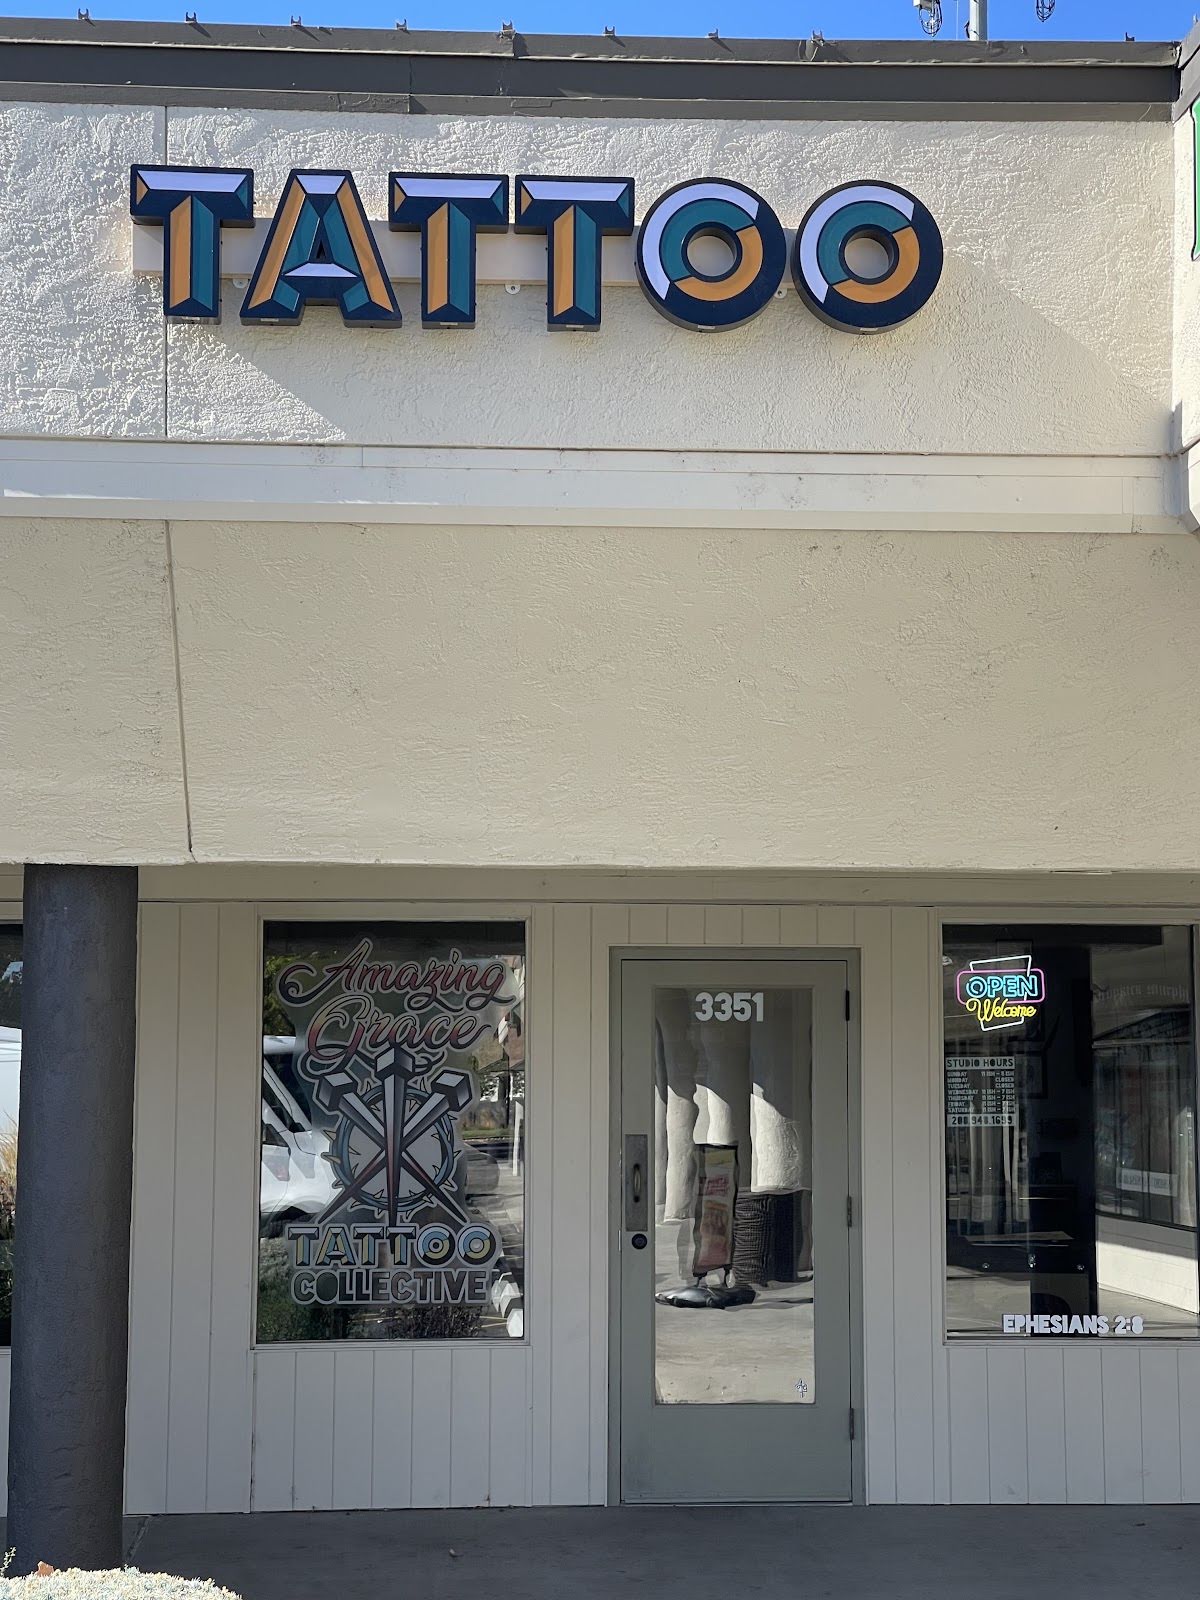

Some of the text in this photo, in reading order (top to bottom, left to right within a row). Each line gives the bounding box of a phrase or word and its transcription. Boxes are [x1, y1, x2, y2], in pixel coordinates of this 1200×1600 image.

[131, 163, 943, 333] TATTOO
[279, 939, 516, 1012] Amazing
[966, 975, 1038, 998] OPEN
[695, 992, 764, 1022] 3351
[966, 997, 1037, 1021] Welcome
[302, 994, 492, 1072] Grace
[946, 1058, 1014, 1067] STUDIO HOURS
[288, 1226, 497, 1266] TATTOO
[293, 1270, 487, 1302] COLLECTIVE
[1003, 1314, 1144, 1335] EPHESIANS 2:8
